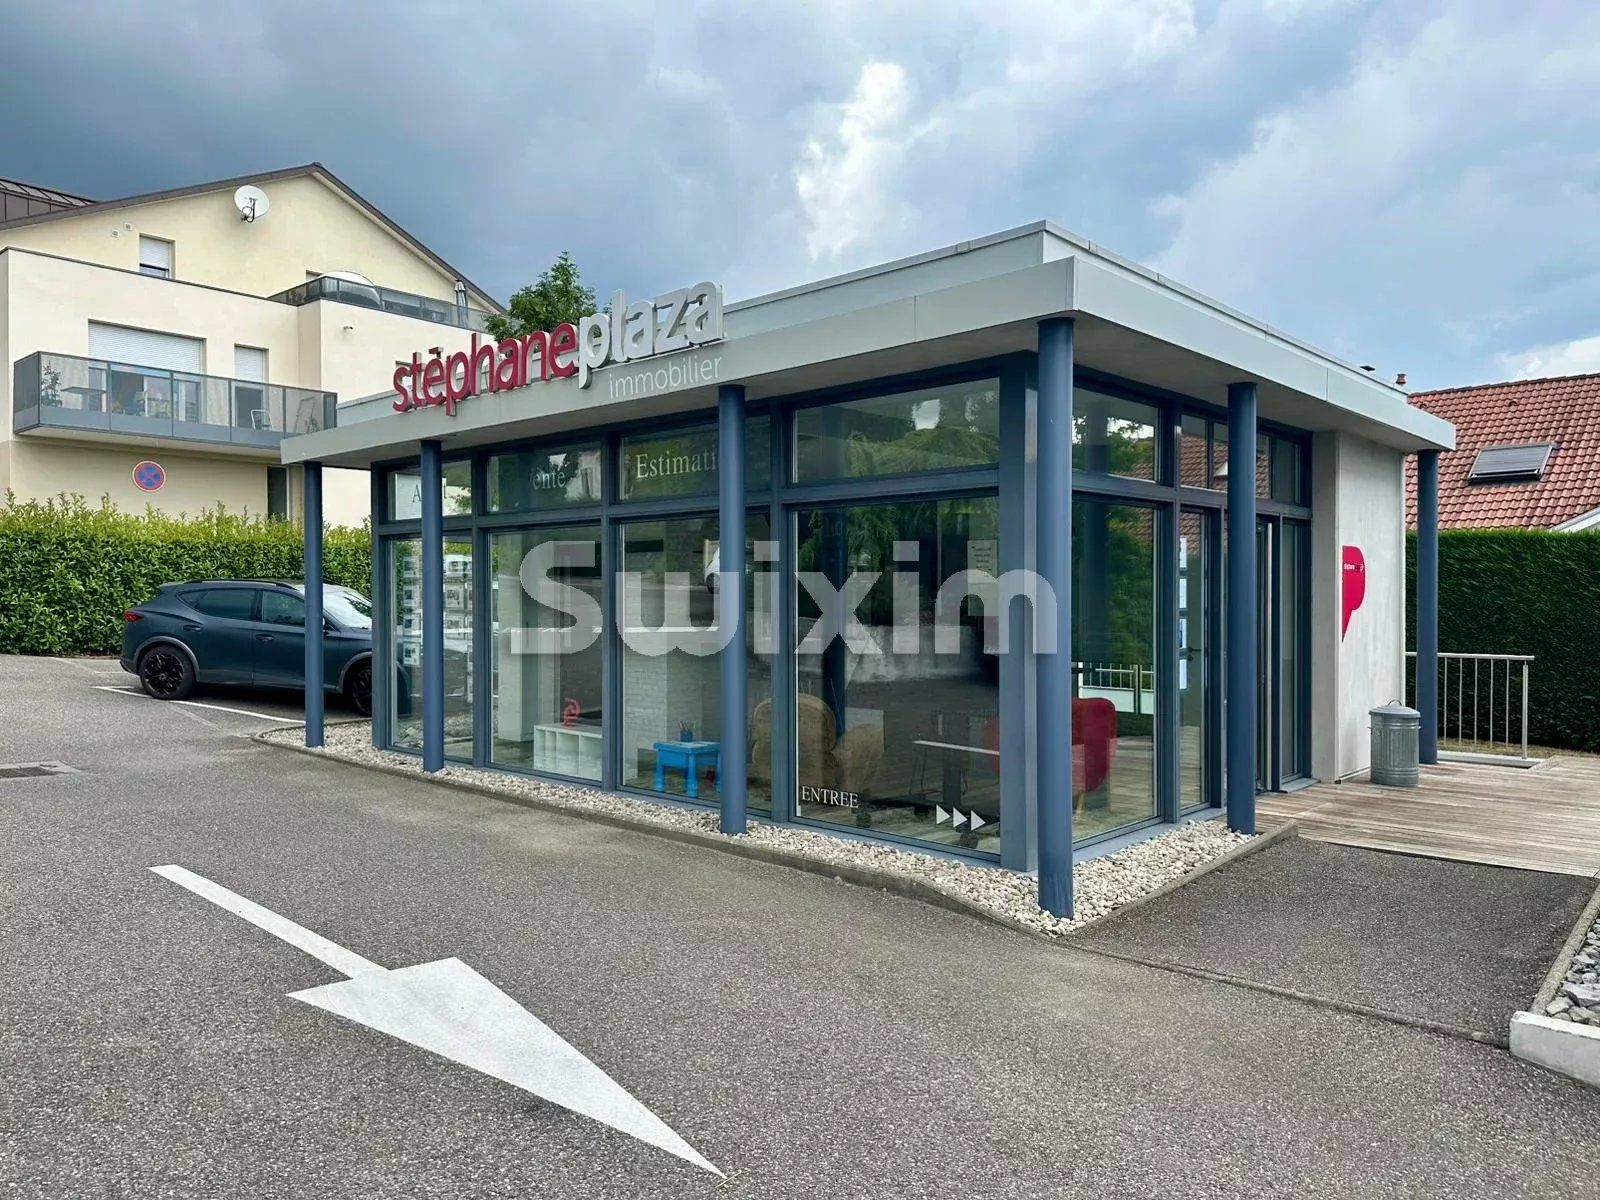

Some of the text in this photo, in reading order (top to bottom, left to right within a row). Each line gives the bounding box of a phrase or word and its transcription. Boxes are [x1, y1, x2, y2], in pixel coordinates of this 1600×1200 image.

[608, 354, 723, 400] immobilier
[636, 444, 720, 479] Estimati
[801, 785, 860, 809] ENTREE
